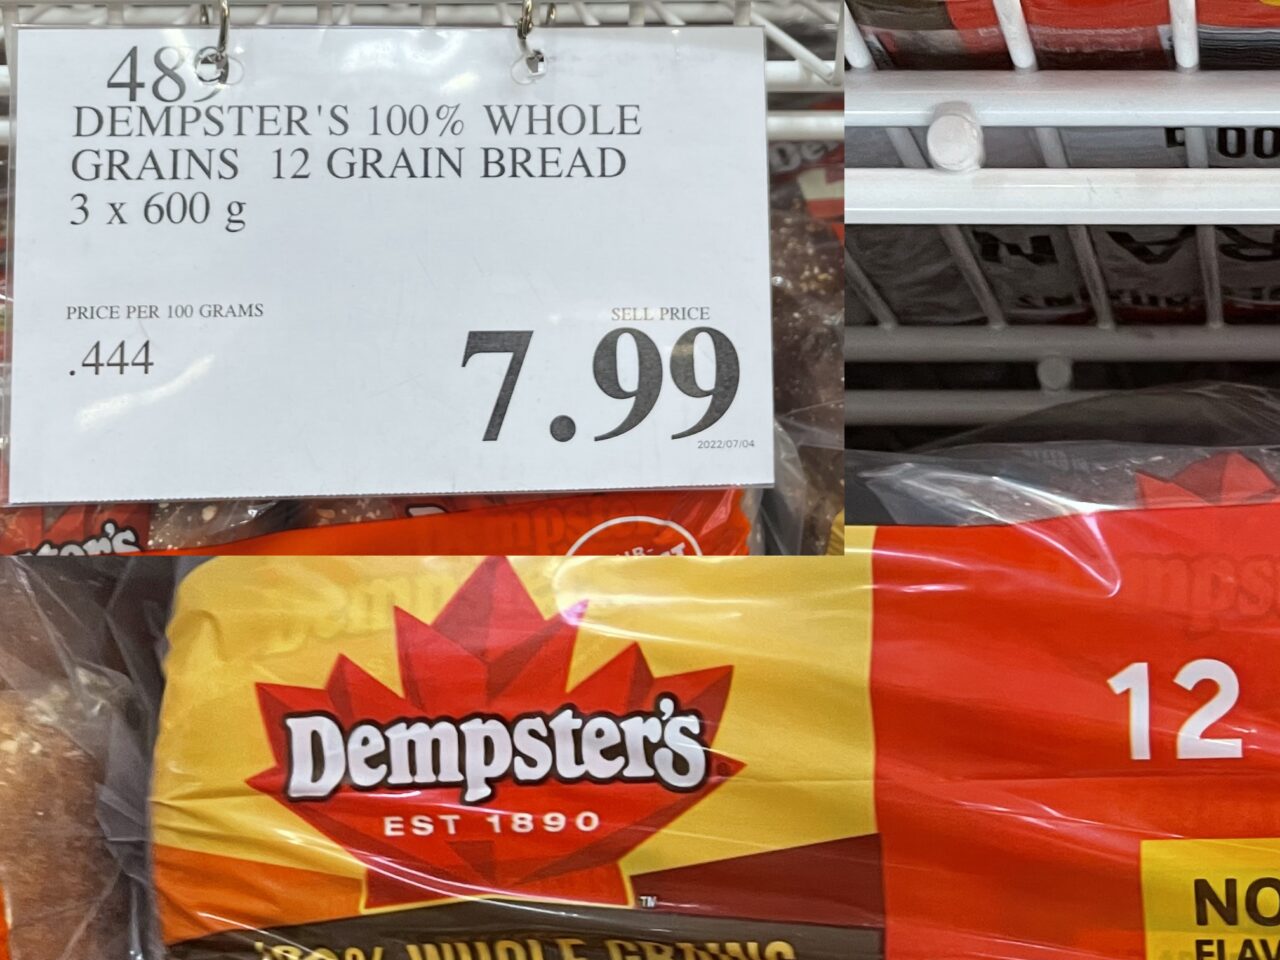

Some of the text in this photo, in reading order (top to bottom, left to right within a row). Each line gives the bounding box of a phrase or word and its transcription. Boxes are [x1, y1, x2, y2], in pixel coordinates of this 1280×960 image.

[72, 103, 643, 139] DEMPSTER'S 100% WHOLE
[70, 146, 627, 182] GRAINS 12 GRAIN BREAD
[70, 191, 248, 232] 3 x 600 g
[66, 304, 265, 321] PRICE PER 100 GRAMS
[611, 307, 711, 322] SELL PRICE
[69, 340, 155, 377] .444
[461, 326, 741, 443] 7.99
[697, 440, 756, 450] 2022/07/04
[1107, 659, 1244, 760] 12
[285, 697, 708, 802] Dempster's
[385, 811, 600, 836] EST 1890
